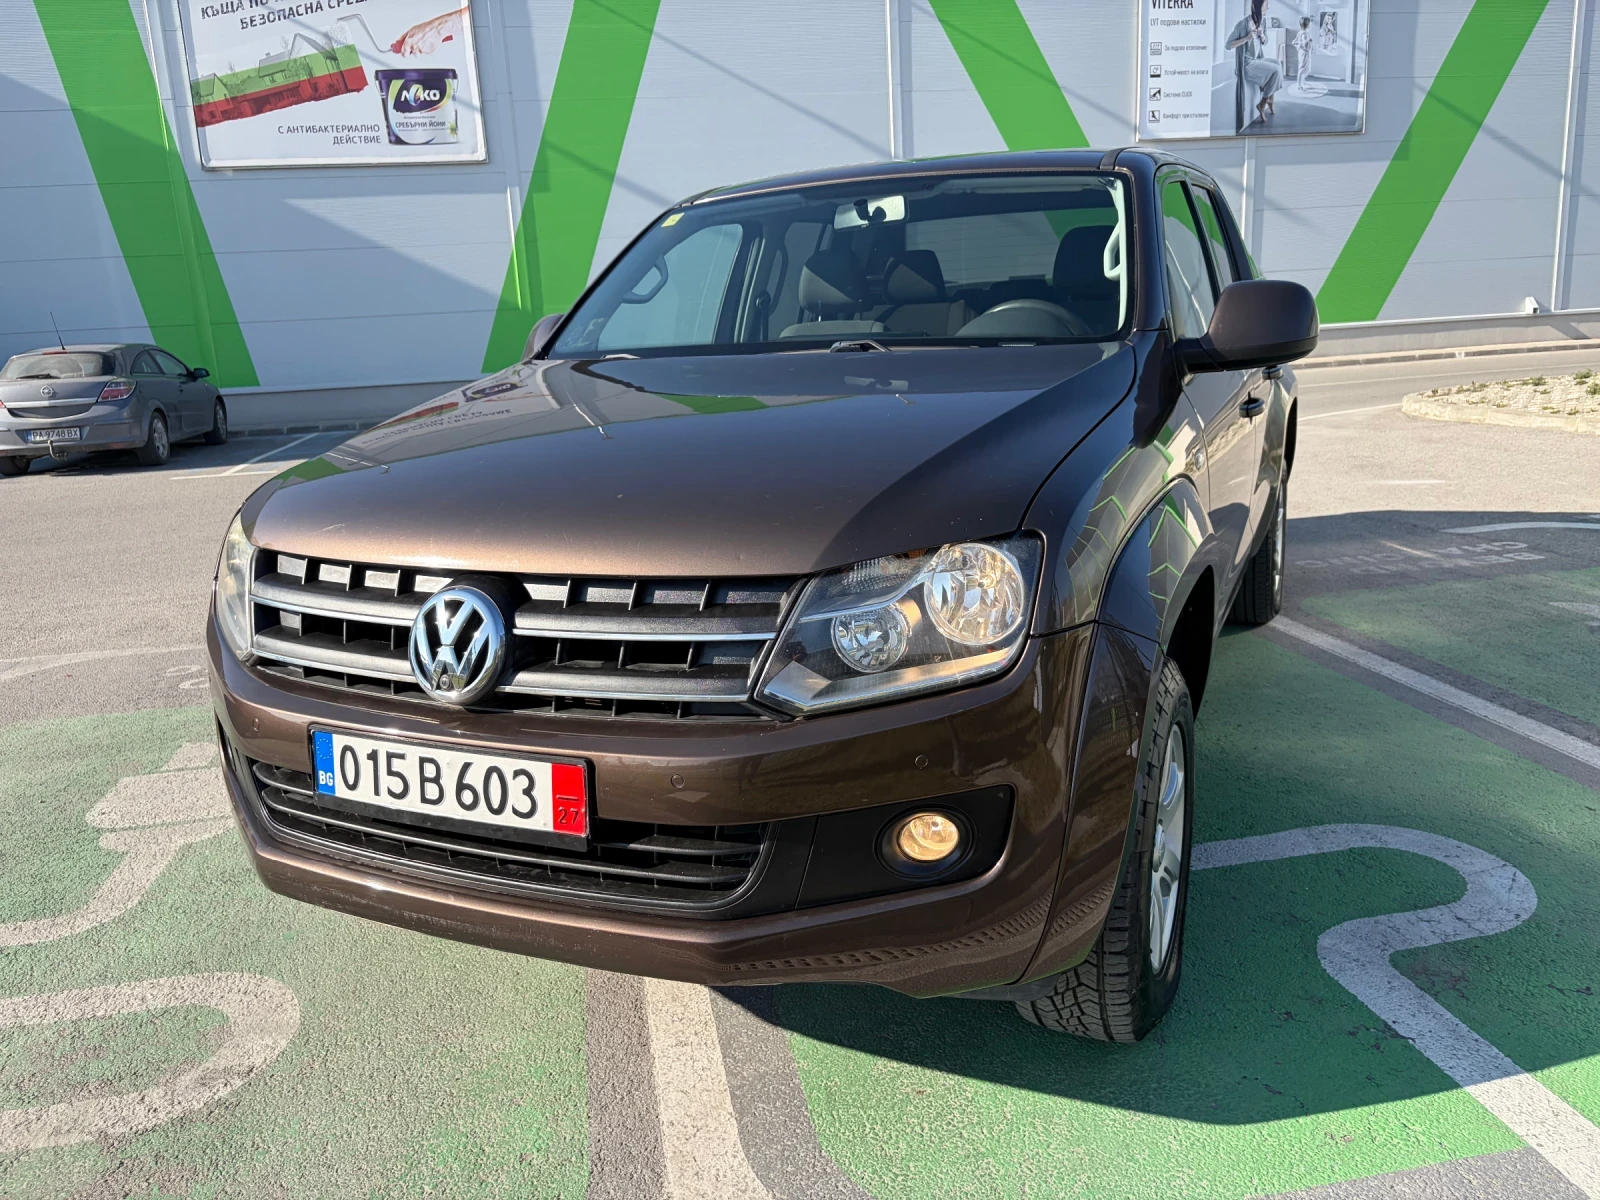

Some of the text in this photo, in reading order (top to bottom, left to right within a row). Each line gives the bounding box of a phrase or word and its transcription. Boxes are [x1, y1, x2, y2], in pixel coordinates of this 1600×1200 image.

[201, 0, 245, 19] КЪЩА
[1151, 0, 1194, 9] VITERRA
[240, 0, 373, 30] БЕЗОПАСНА СРЕ
[1160, 19, 1180, 27] подови
[278, 124, 380, 134] С АНТИБАКТЕРИАЛНО
[428, 120, 446, 128] ЙОНИ
[332, 134, 381, 145] ДЕЙСТВИЕ
[319, 770, 334, 787] BG
[558, 806, 579, 826] 27
